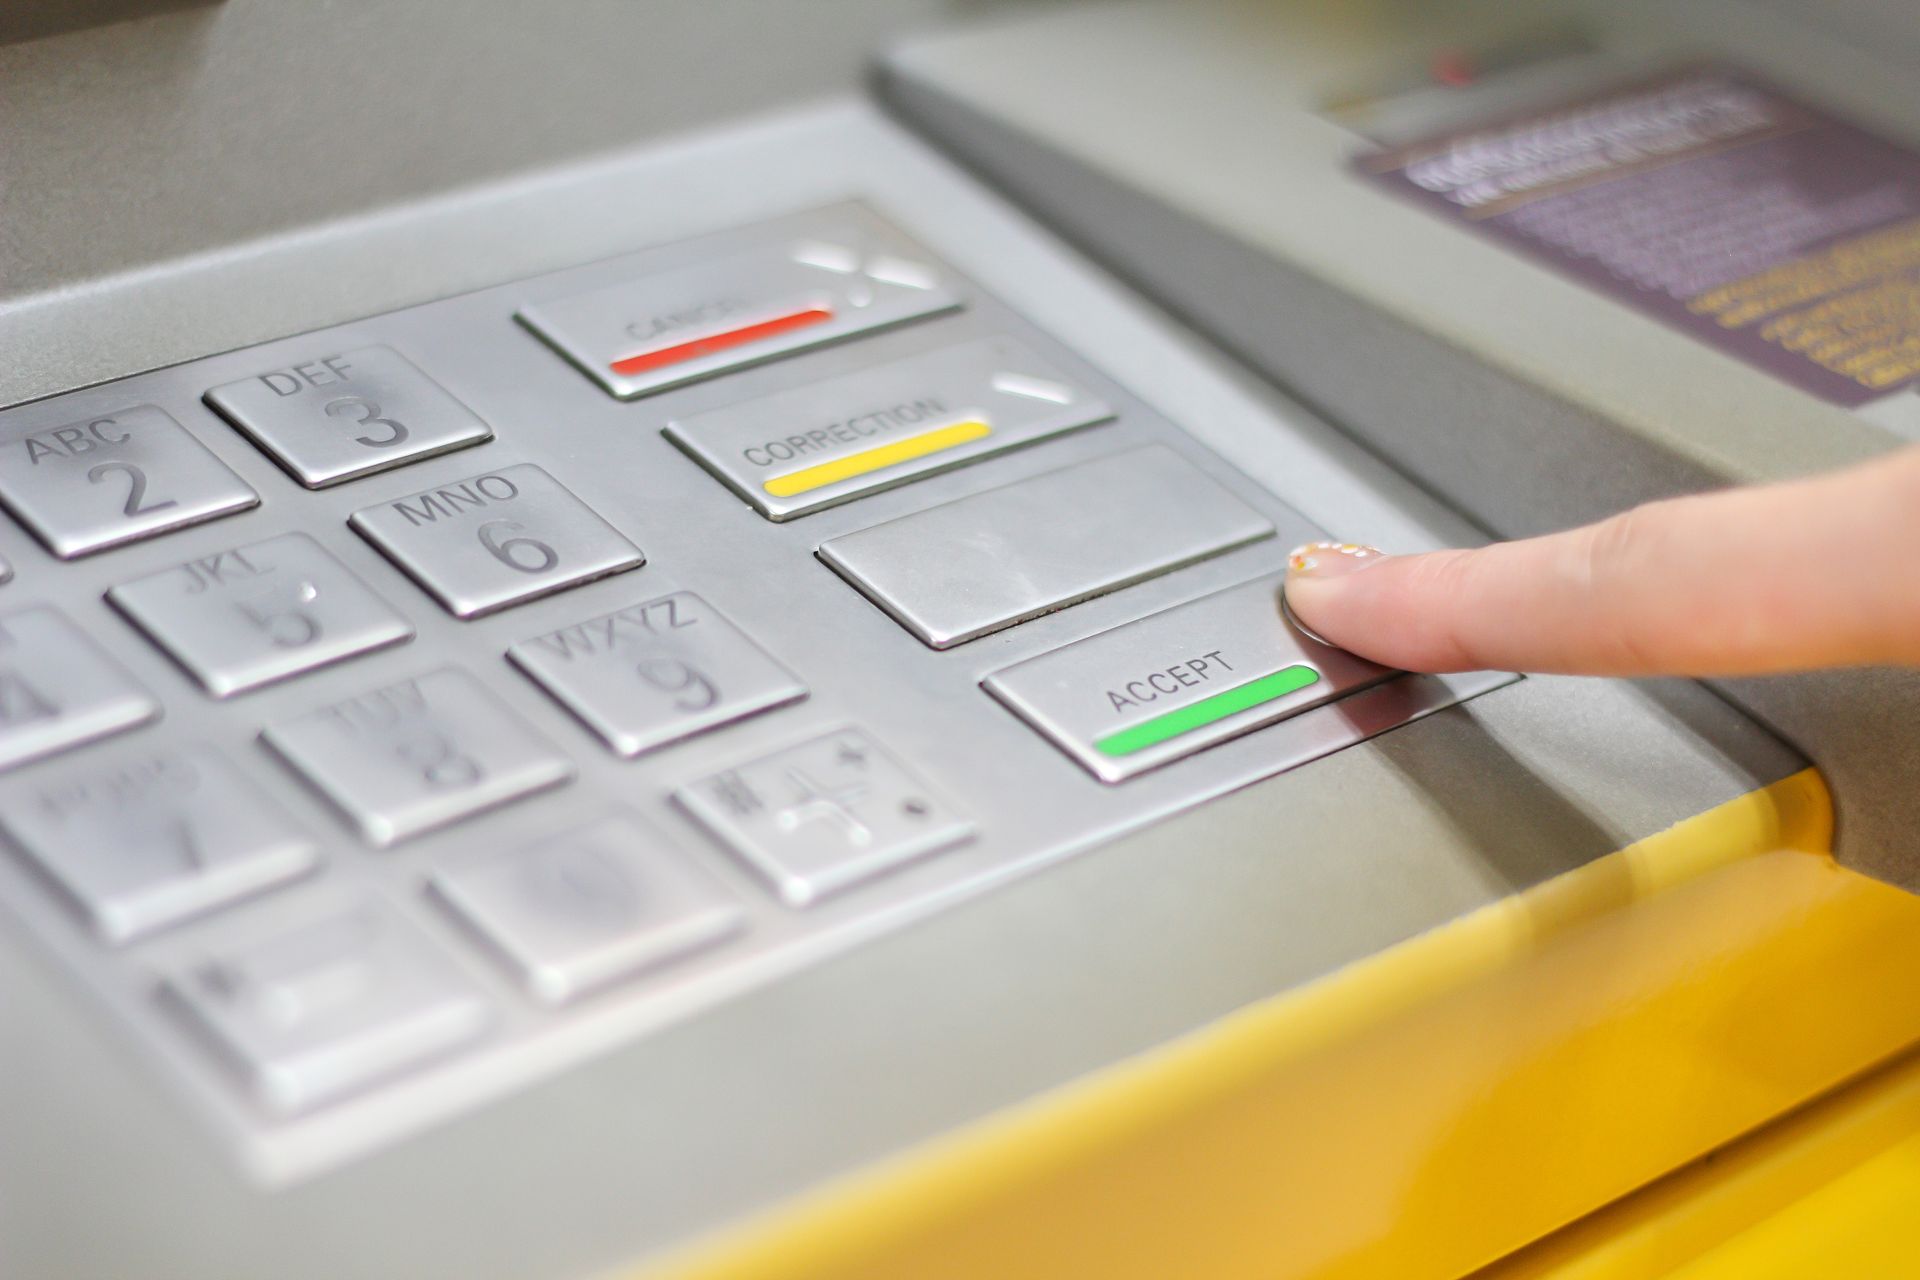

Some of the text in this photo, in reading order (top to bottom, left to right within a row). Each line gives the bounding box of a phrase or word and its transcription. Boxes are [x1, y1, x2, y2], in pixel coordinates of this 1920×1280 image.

[257, 355, 358, 400] DEF
[24, 416, 132, 466] ABC
[323, 395, 411, 449] 3
[742, 399, 947, 469] CORRECTION
[86, 460, 179, 517] 2
[391, 474, 521, 528] MNO
[476, 517, 561, 575] 6
[531, 598, 698, 662] WXYZ
[636, 658, 722, 712] 9
[1105, 649, 1236, 714] ACCEPT
